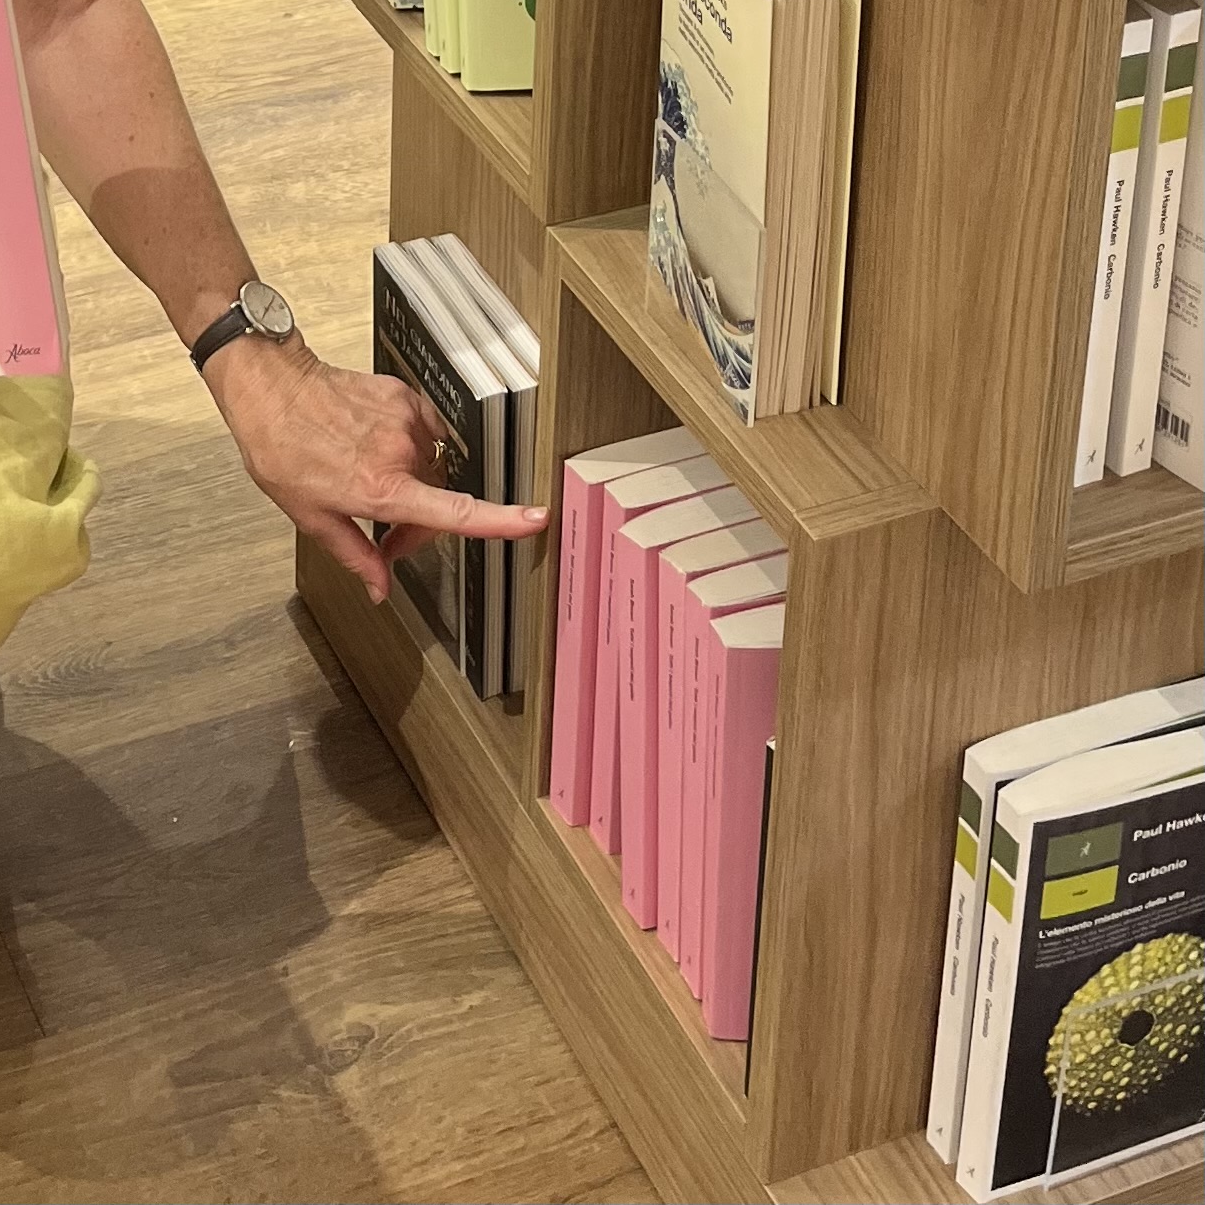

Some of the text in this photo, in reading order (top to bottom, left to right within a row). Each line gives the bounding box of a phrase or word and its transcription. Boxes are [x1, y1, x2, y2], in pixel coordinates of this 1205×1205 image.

[1102, 179, 1124, 300] Paul Hawken Carbonio
[1152, 169, 1173, 290] Paul Hawken Carbonio
[5, 344, 41, 364] Aboca
[1133, 824, 1163, 841] Paul
[1125, 856, 1189, 884] Carbonio
[1037, 890, 1186, 940] L'elemento misterioso della vita
